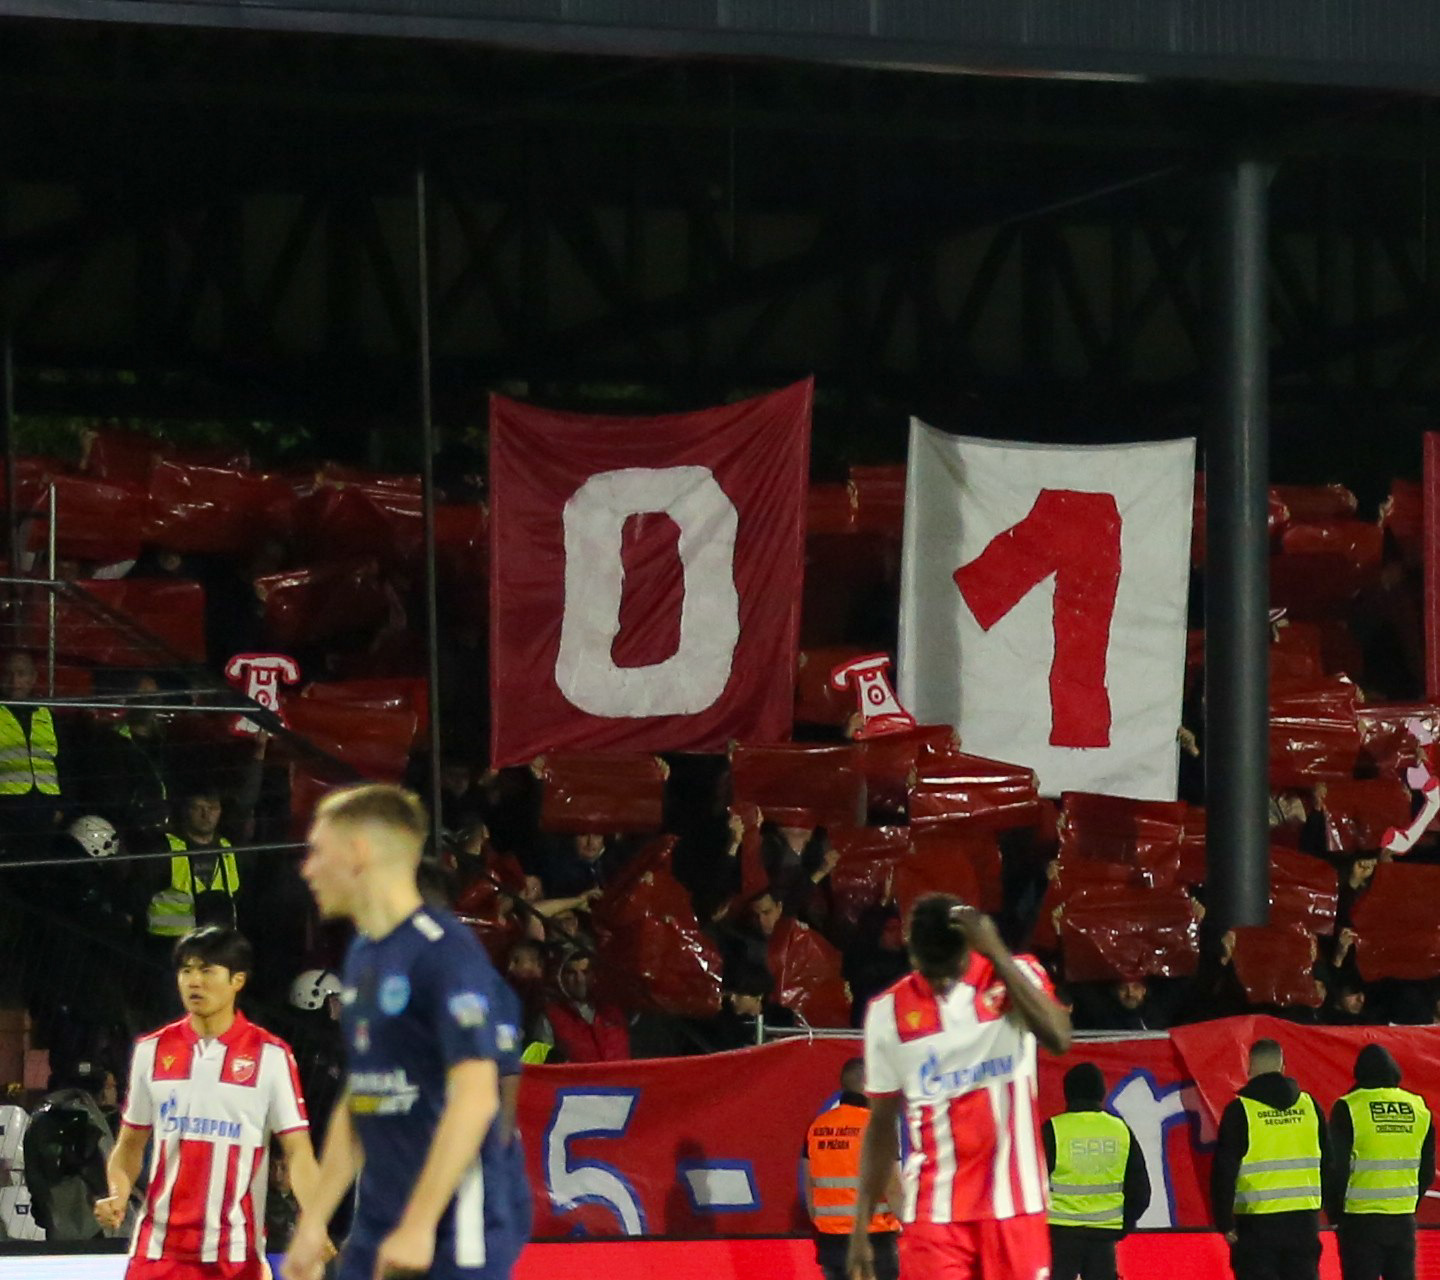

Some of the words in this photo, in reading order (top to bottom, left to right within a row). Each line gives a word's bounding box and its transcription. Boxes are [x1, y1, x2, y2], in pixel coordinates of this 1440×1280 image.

[555, 465, 741, 719] 0
[952, 488, 1122, 749] 1
[1371, 1101, 1413, 1115] SAB
[1264, 1116, 1302, 1126] SECURITY
